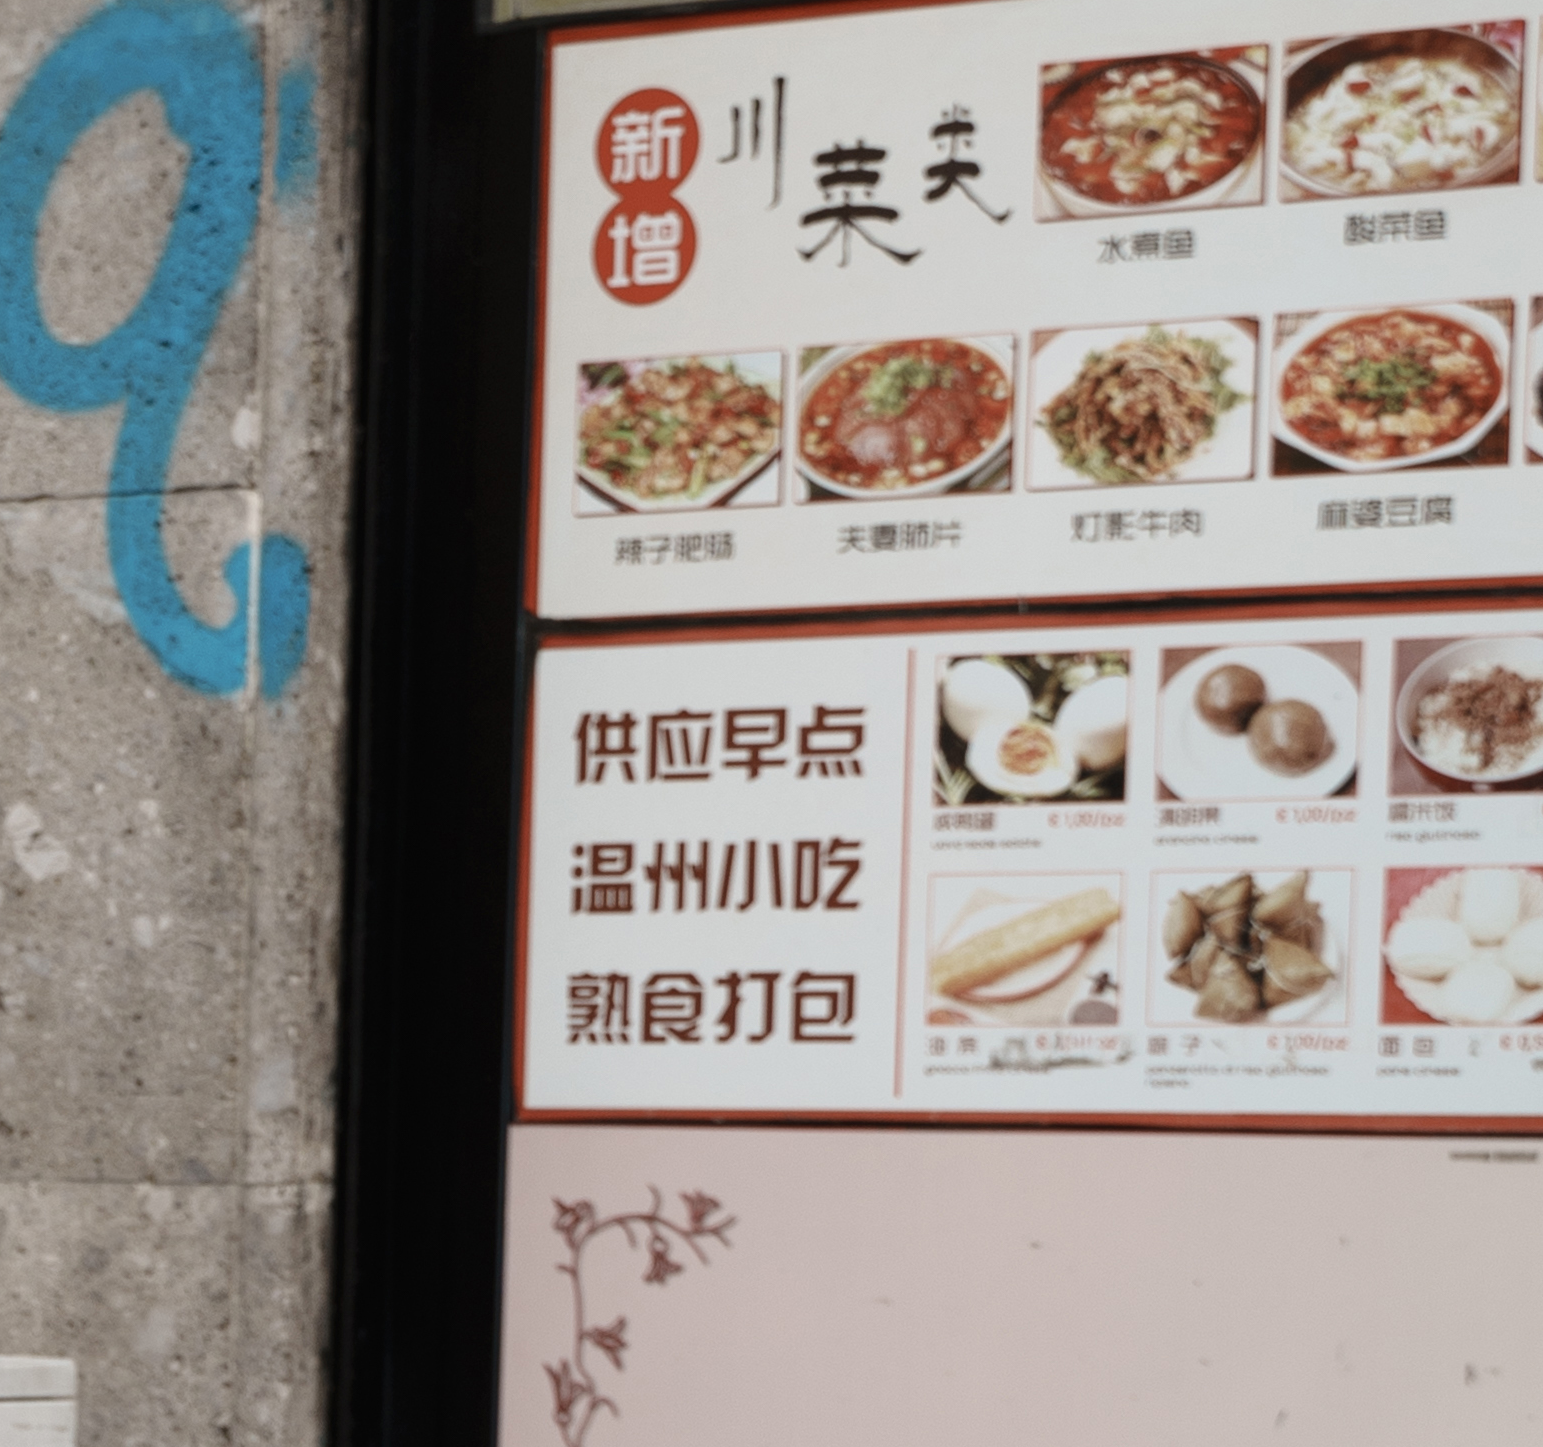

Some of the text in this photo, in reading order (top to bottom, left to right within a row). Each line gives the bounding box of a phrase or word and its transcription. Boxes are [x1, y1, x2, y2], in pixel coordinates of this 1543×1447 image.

[607, 105, 687, 288] 新增
[716, 75, 1011, 270] 川菜类
[1316, 494, 1454, 530] 麻婆豆腐
[573, 704, 867, 785] 供应早点
[569, 836, 864, 914] 温州小吃
[565, 970, 858, 1046] 熟食打包
